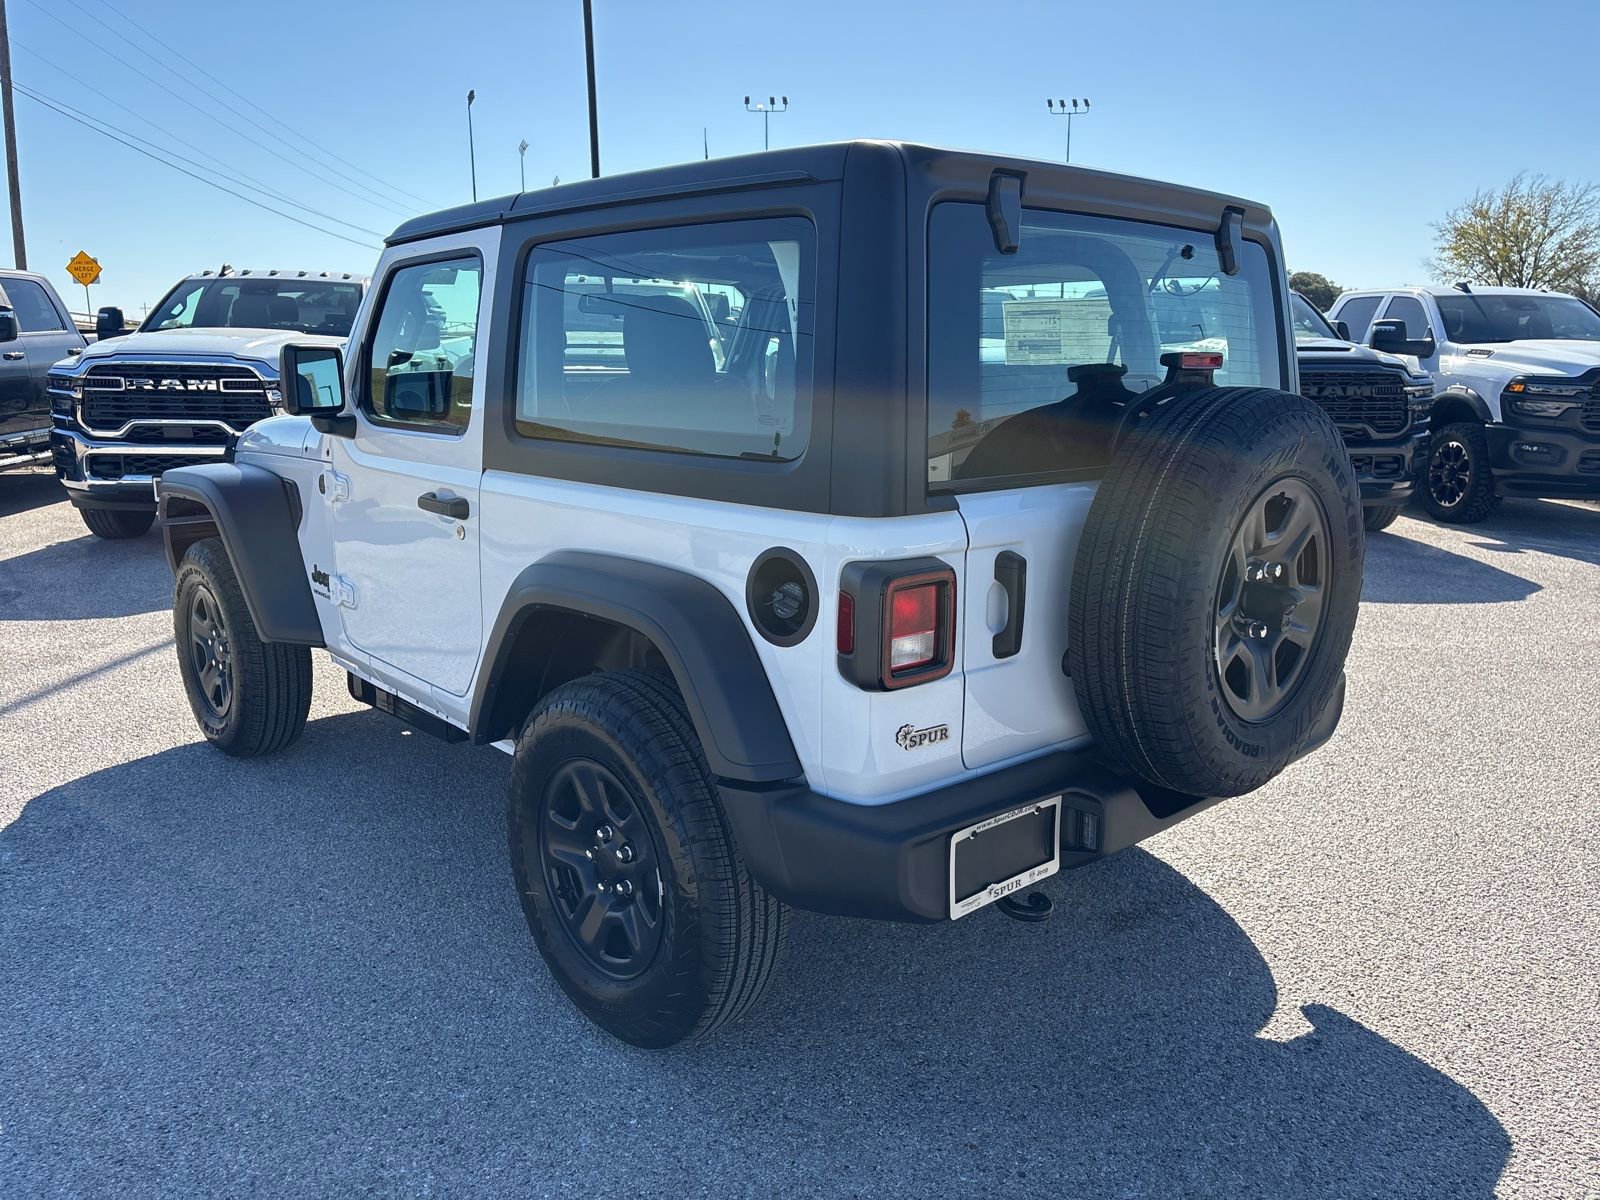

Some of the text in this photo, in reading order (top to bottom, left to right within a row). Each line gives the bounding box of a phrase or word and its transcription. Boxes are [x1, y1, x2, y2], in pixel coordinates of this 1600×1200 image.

[125, 378, 217, 391] RAM
[1300, 384, 1372, 397] RAM
[909, 728, 949, 748] SPUR
[1036, 867, 1049, 877] Jeep
[993, 879, 1022, 898] SPUR
